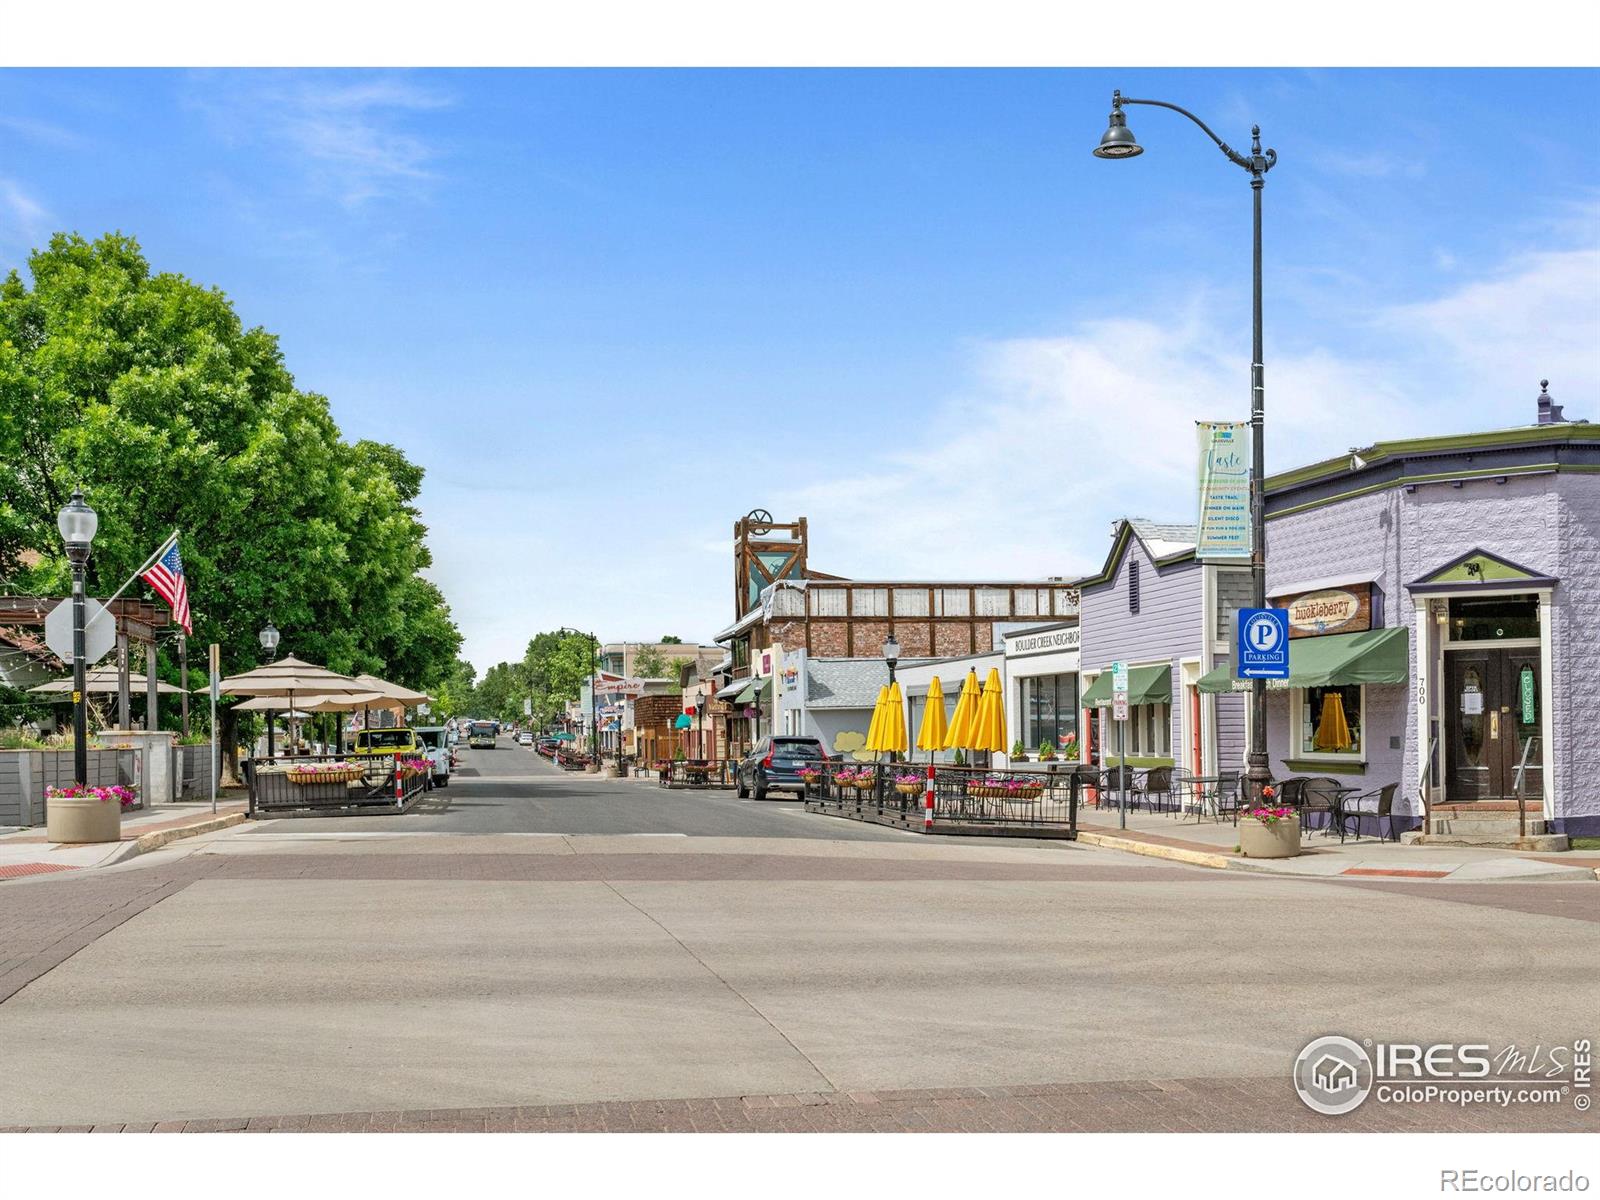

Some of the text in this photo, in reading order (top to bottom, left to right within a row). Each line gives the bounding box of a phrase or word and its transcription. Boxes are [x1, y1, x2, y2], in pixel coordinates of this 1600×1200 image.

[1295, 600, 1350, 621] huckleberry
[1249, 614, 1279, 626] LOUISVILLE
[1015, 637, 1037, 652] BOULDER
[1037, 635, 1053, 649] CREEK
[1256, 624, 1273, 646] P
[1248, 653, 1280, 661] PARKING
[595, 679, 641, 692] Empire
[1523, 676, 1533, 721] CLOSED
